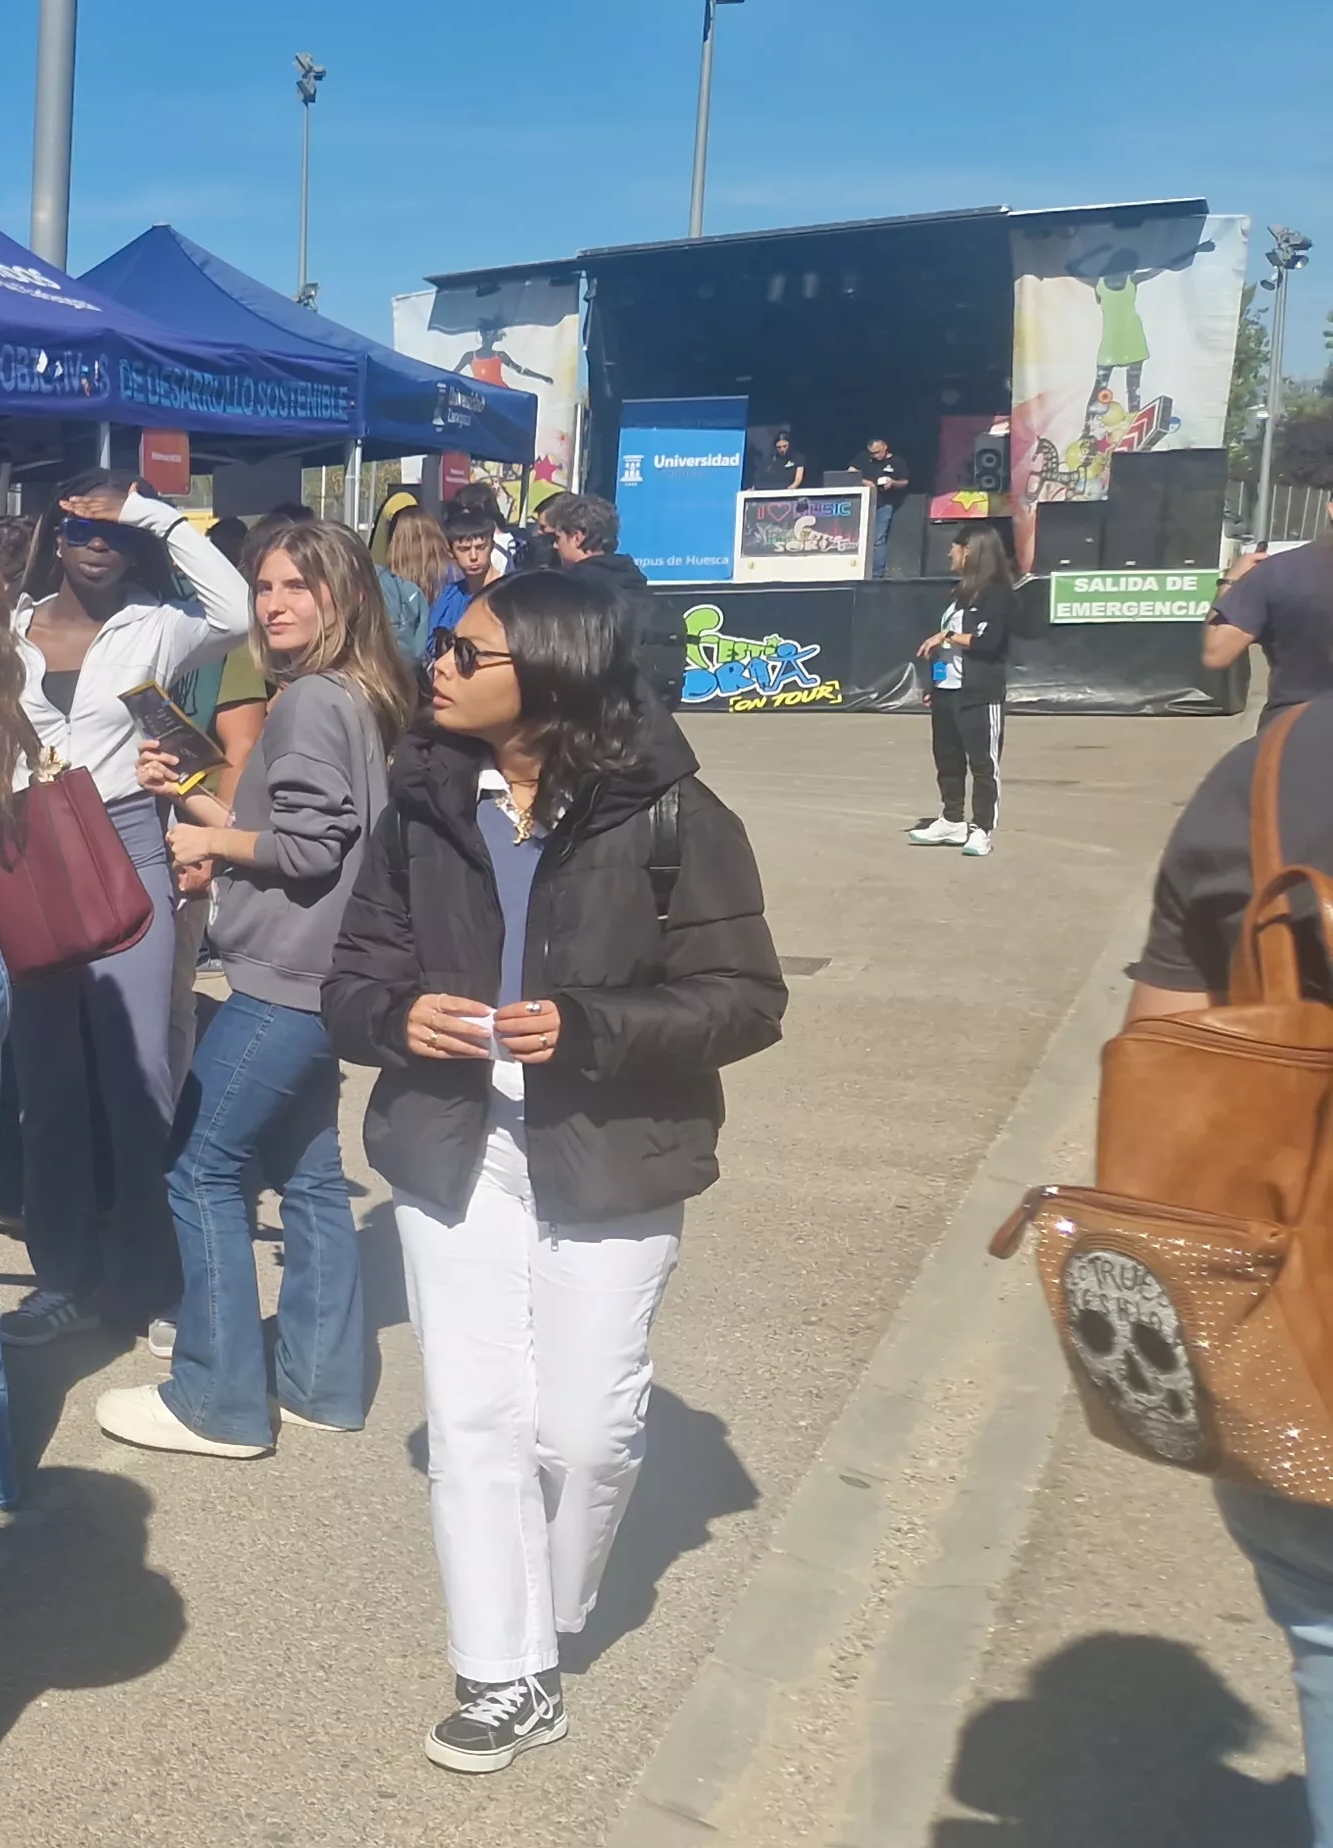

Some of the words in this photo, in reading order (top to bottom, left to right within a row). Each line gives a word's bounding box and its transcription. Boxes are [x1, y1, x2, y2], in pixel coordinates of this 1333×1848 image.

[119, 359, 145, 399] DE
[147, 366, 254, 416] DESARROLLO
[258, 379, 349, 421] SOSTENIBLE
[654, 453, 740, 468] Universidad
[633, 556, 664, 567] mpus
[667, 554, 683, 566] de
[686, 555, 730, 566] Huesca
[1074, 577, 1159, 592] SALIDA
[1166, 576, 1198, 591] DE
[1057, 601, 1210, 617] EMERGENCIA
[681, 642, 821, 702] ORIA
[735, 697, 767, 712] ON
[773, 685, 835, 708] TOUR
